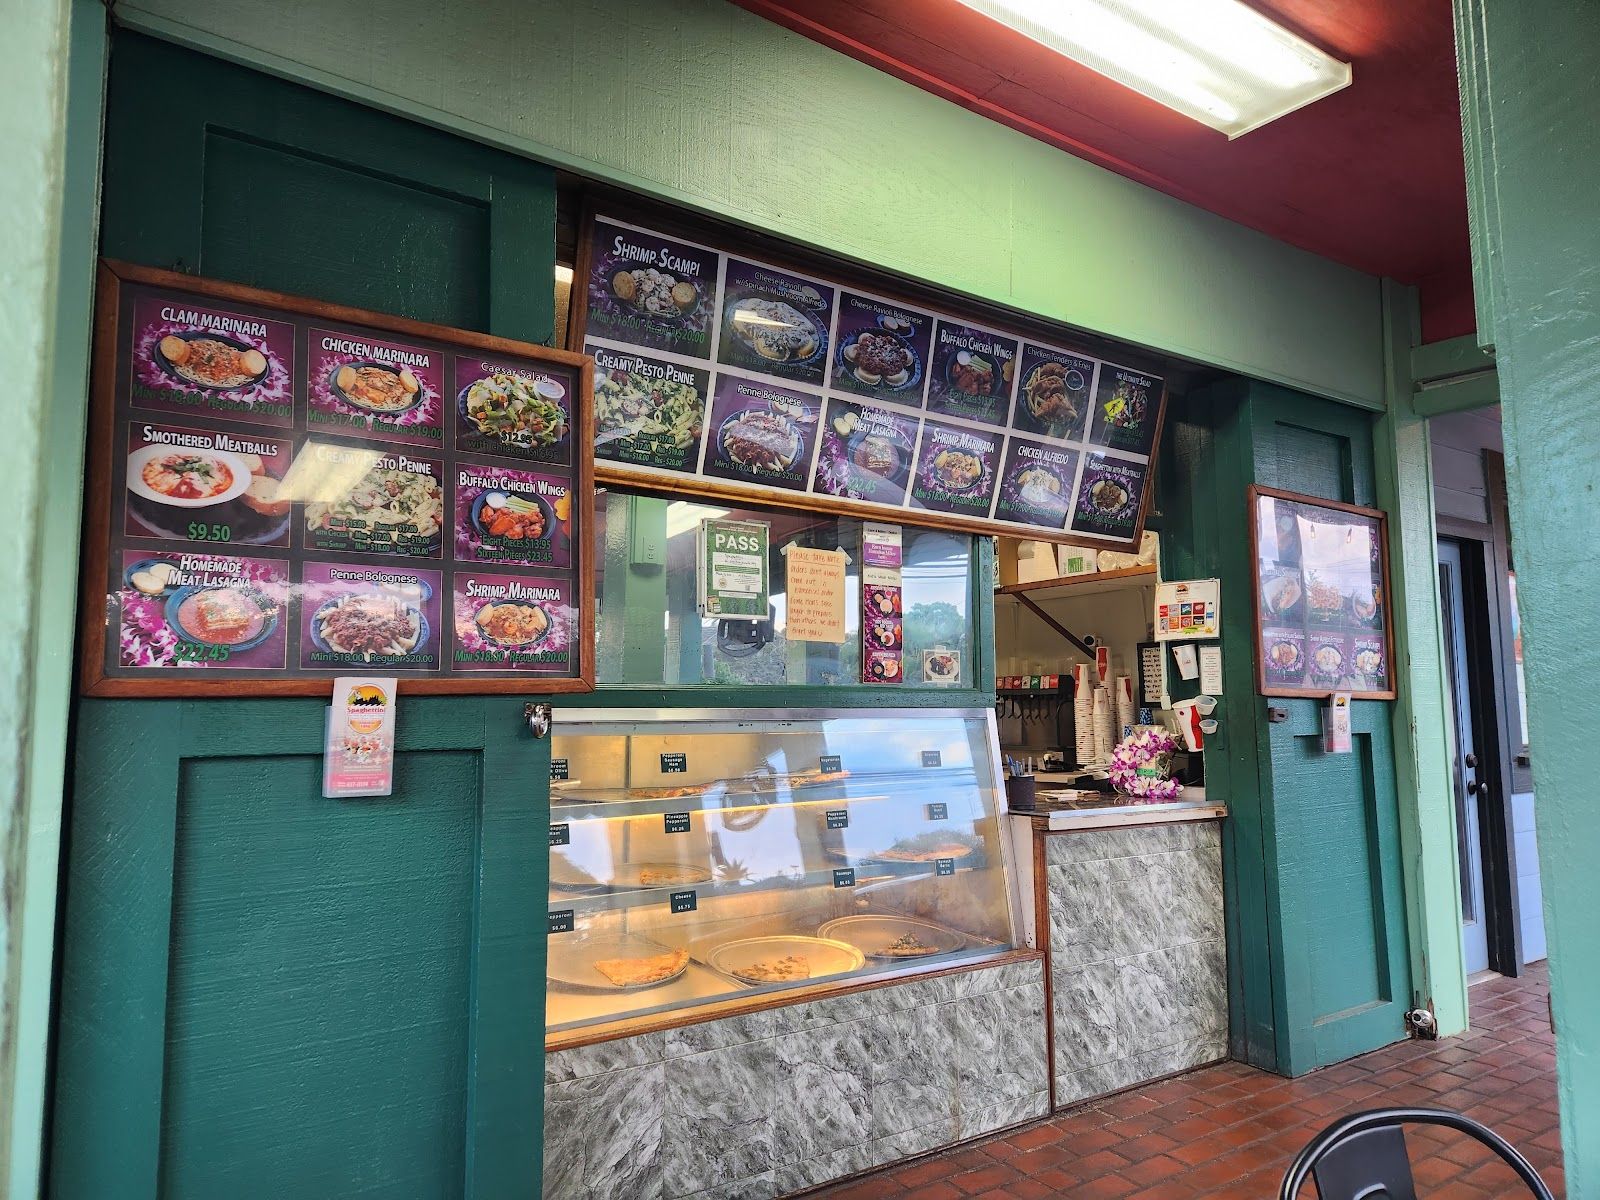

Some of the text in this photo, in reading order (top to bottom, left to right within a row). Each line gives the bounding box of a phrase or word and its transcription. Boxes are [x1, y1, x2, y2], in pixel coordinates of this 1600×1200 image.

[612, 236, 700, 277] SHRIMP SCAMPI
[754, 271, 802, 292] Cheese Ravioli
[850, 299, 873, 311] Cheese
[160, 307, 267, 338] CLAM MARINARA
[321, 337, 430, 368] CHICKEN MARINARA
[941, 329, 1012, 360] BUFFALO CHICKEN WINGS
[594, 350, 695, 386] CREAMY PESTO PENNE
[1027, 346, 1051, 360] Chicken
[1051, 353, 1073, 366] Tenders
[1078, 360, 1091, 371] Fries
[481, 362, 548, 383] Caesar Salad
[737, 384, 802, 407] Penne Bolognese
[251, 400, 292, 418] $20.00
[860, 407, 895, 426] HOMEMADE
[331, 412, 366, 428] $17.00
[372, 418, 408, 433] REGULAR
[410, 423, 443, 439] $19.00
[852, 418, 897, 439] MEAT LASAGNA
[143, 425, 278, 457] SMOTHERED MEATBALLS
[500, 431, 533, 445] $12.95
[932, 428, 995, 454] SHRIMP MARINARA
[363, 452, 397, 470] PESTO
[398, 456, 432, 475] PENNE
[1017, 445, 1069, 465] CHICKEN ALFREDO
[714, 459, 803, 481] Mini $18.00 Regular $20.00
[459, 471, 565, 497] BUFFALO CHICKEN WINGS
[187, 521, 231, 542] $9.50
[370, 532, 391, 542] $17.00
[410, 535, 431, 546] $19.00
[370, 543, 391, 553] $18.00
[409, 546, 429, 556] $20.00
[482, 535, 551, 550] EIGHT PIECES $13.95
[715, 533, 759, 552] PASS
[179, 554, 242, 573] HOMEMADE
[477, 547, 504, 559] SIXTEEN
[526, 550, 553, 562] $23.45
[167, 569, 251, 589] MEAT LASAGNA
[330, 568, 417, 585] Penne Bolognese
[465, 579, 561, 601] SHRIMP MARINARA
[173, 642, 230, 662] $22.45
[310, 652, 433, 664] Mini $18.00 Regular $20.00
[454, 650, 473, 662] MINI
[509, 650, 541, 663] REGULAR
[541, 650, 568, 663] $20.00
